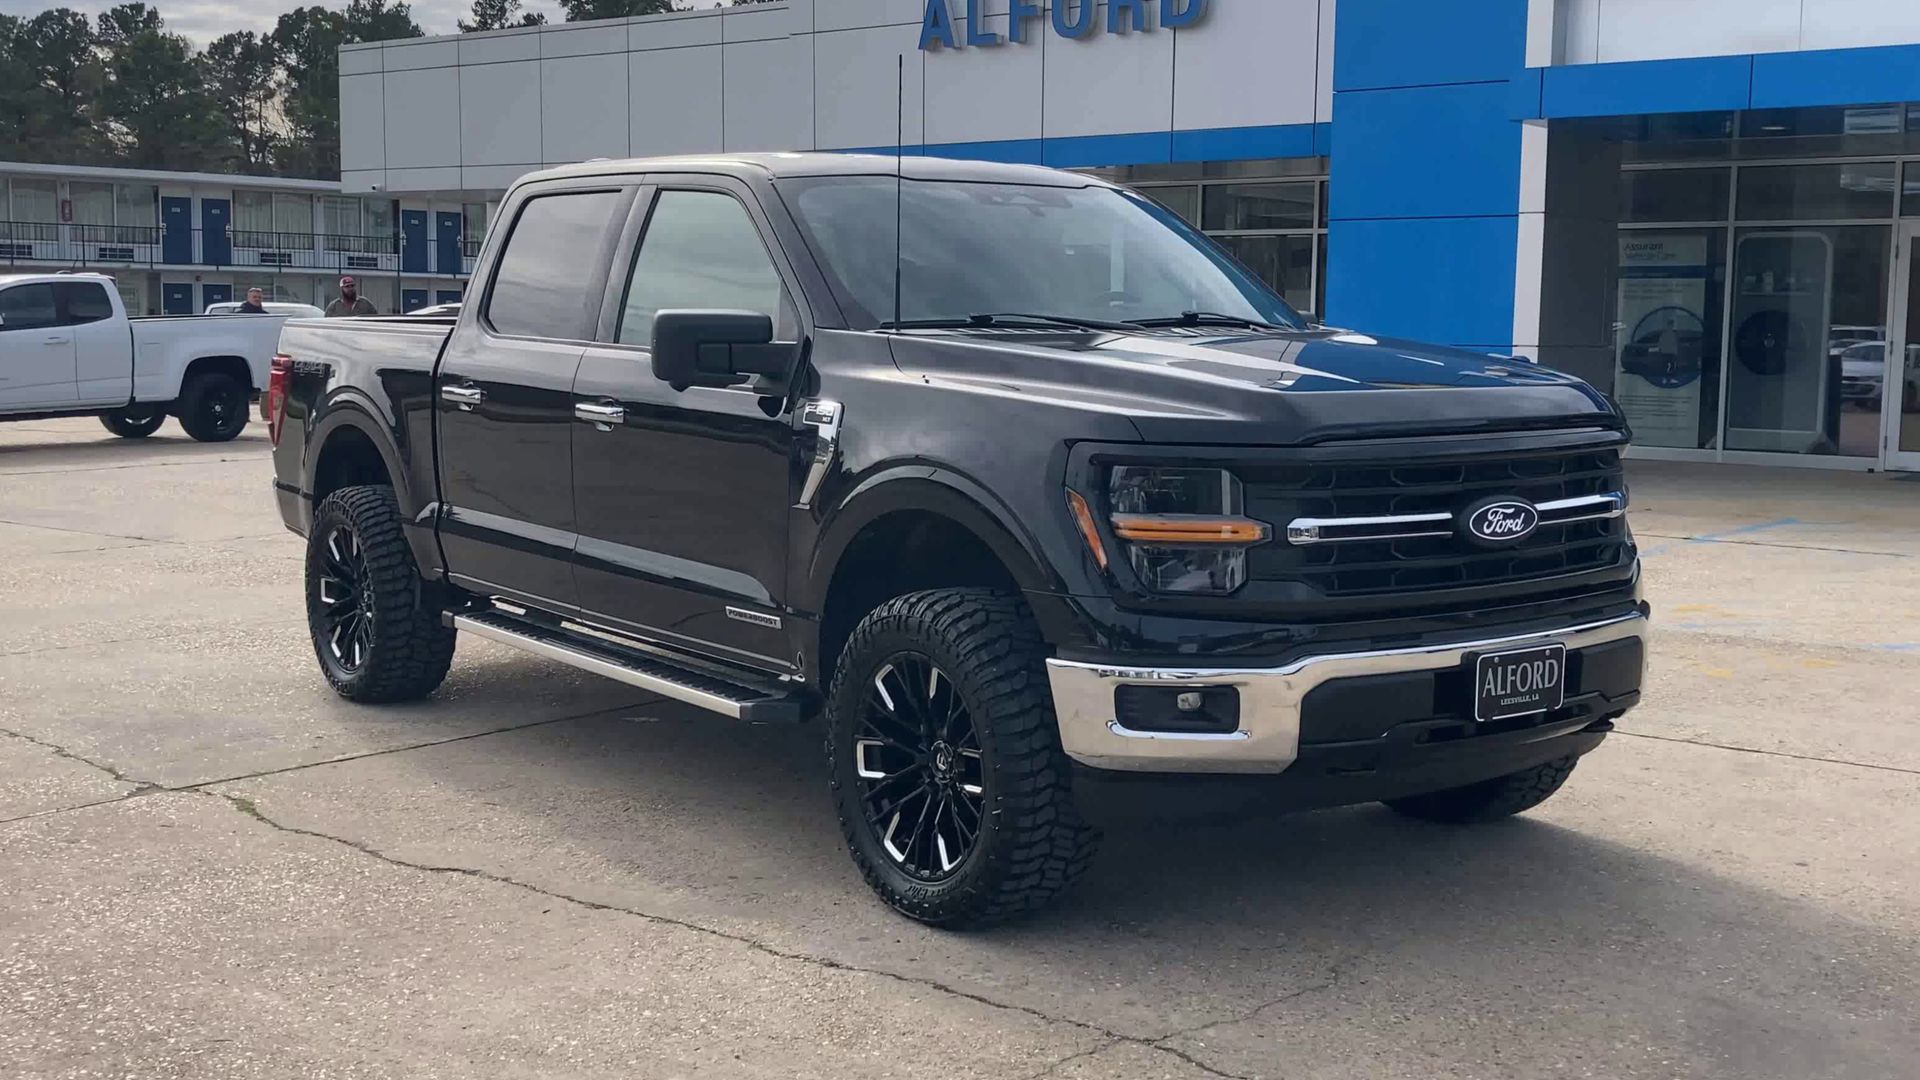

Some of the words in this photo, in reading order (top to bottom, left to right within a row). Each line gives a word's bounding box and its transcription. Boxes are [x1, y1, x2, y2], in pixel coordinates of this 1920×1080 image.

[918, 0, 1195, 49] ALFORD
[1483, 507, 1525, 534] Ford
[1482, 659, 1559, 698] ALFORD
